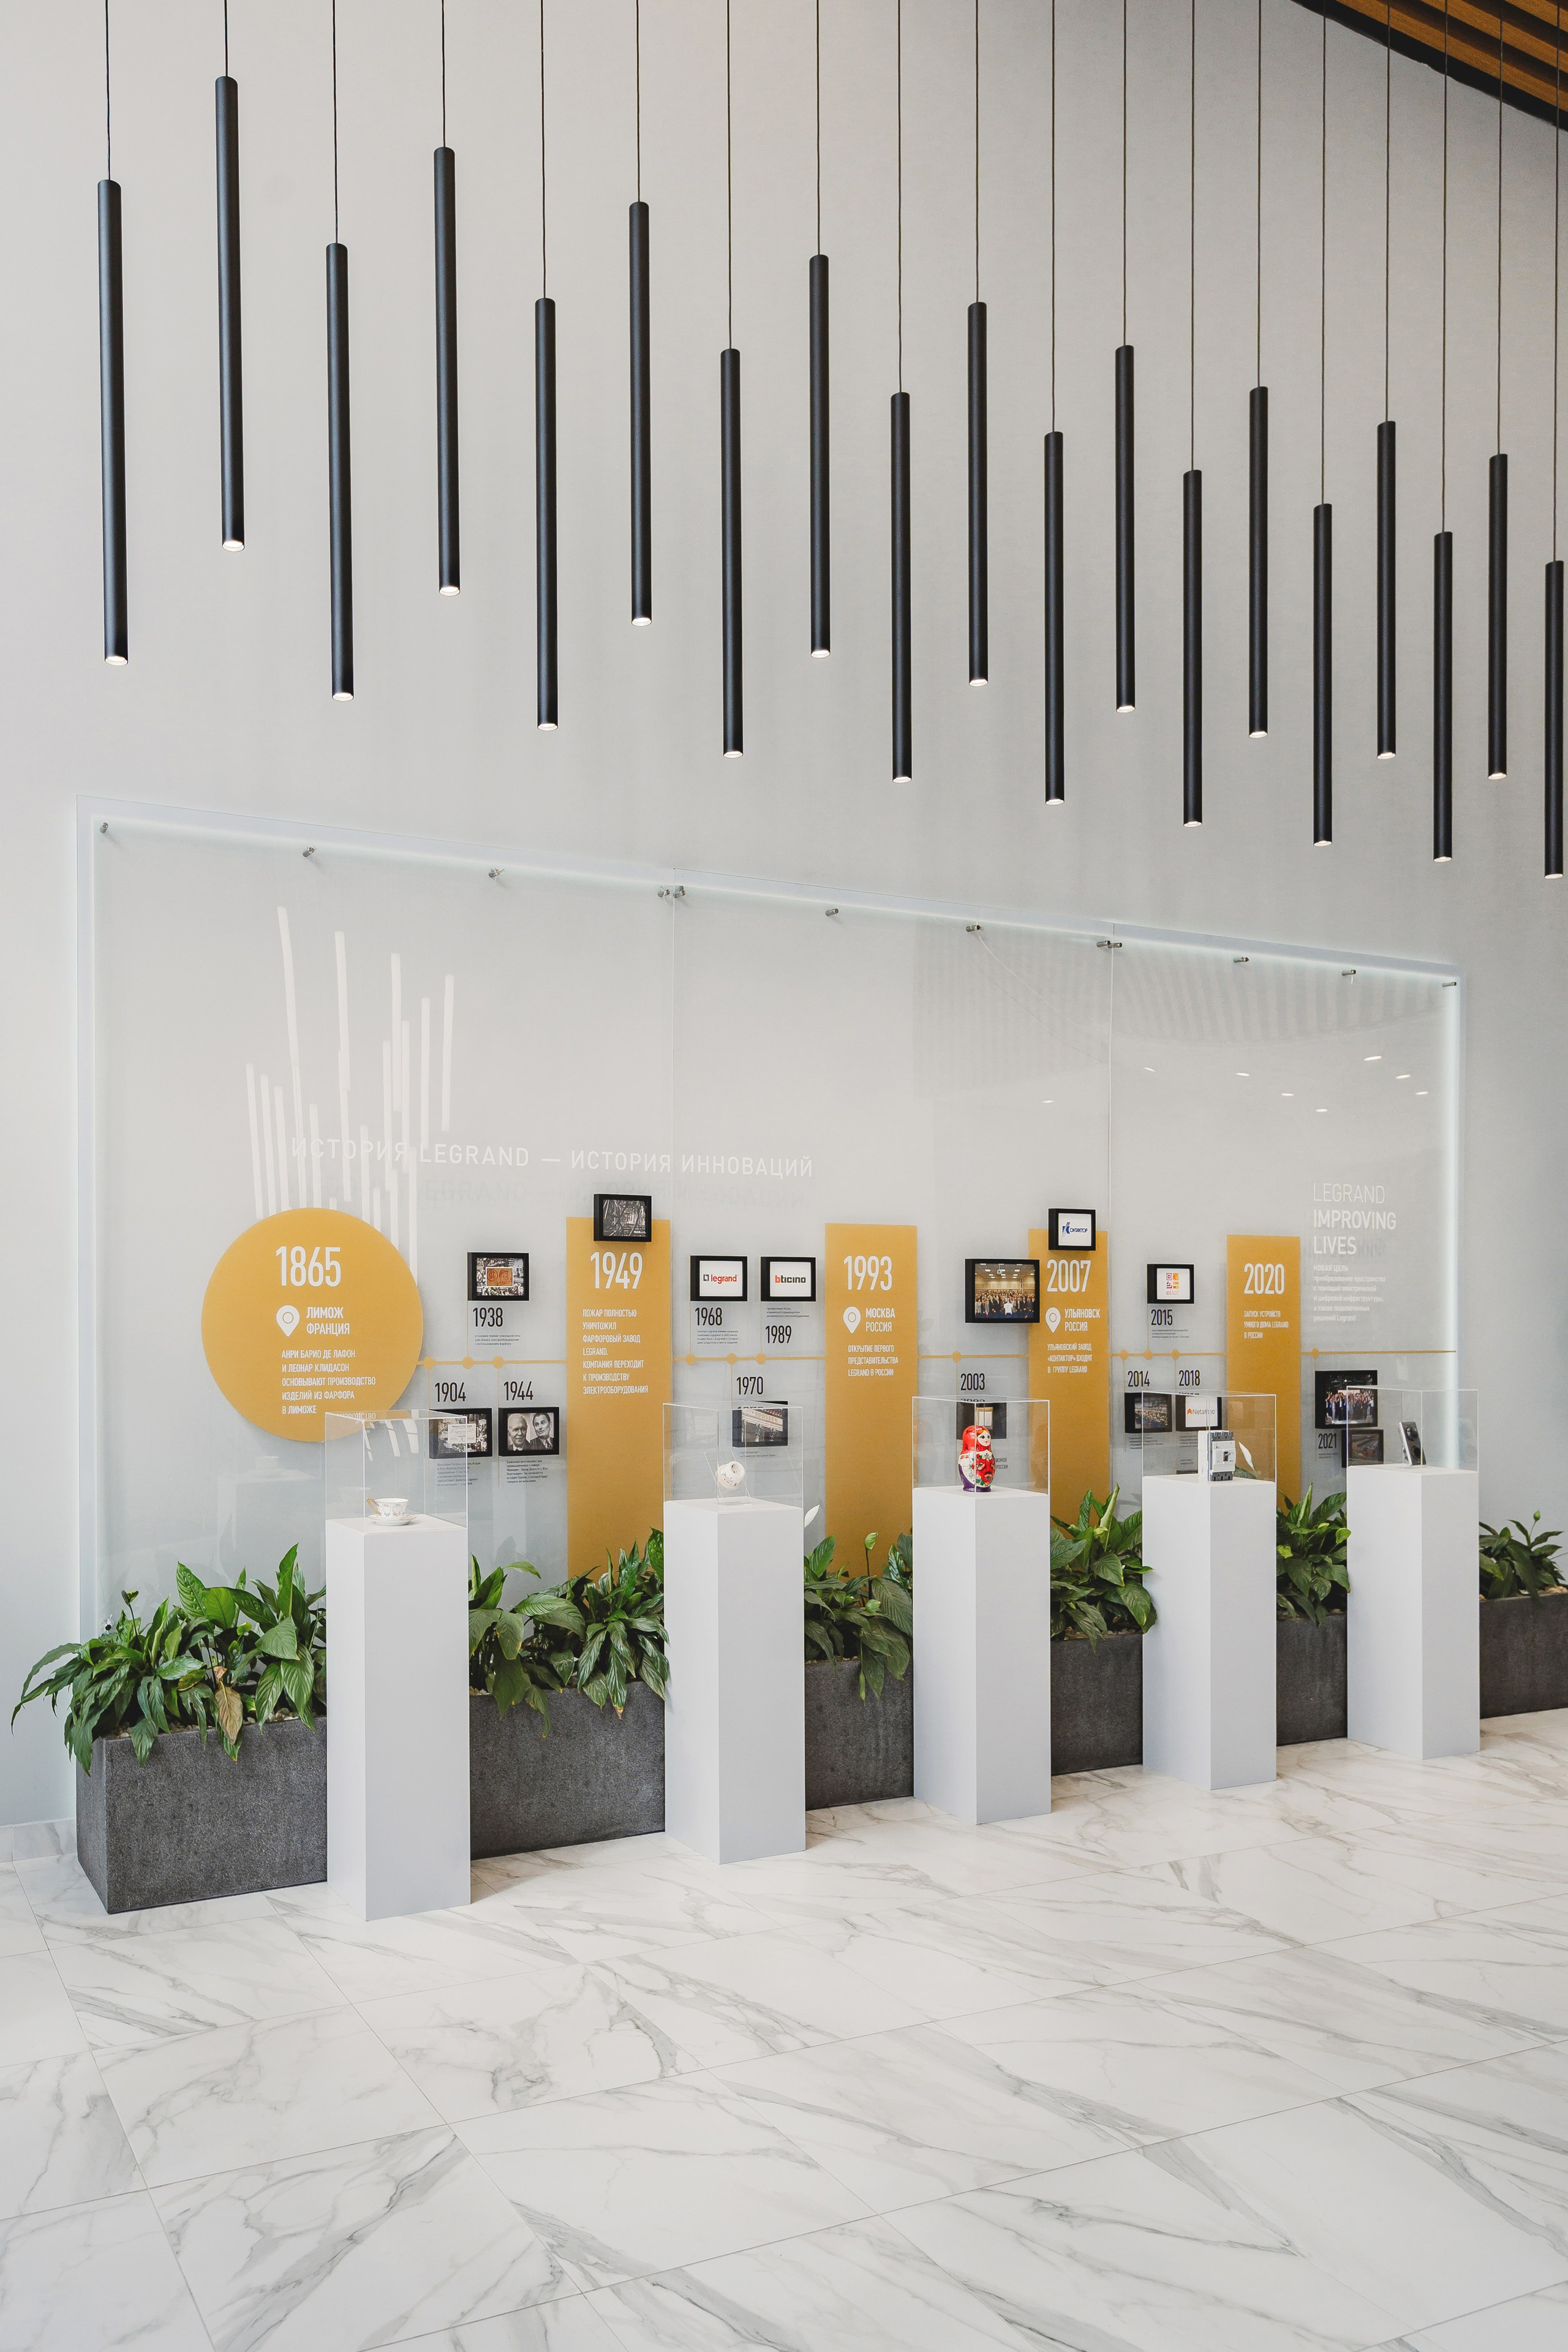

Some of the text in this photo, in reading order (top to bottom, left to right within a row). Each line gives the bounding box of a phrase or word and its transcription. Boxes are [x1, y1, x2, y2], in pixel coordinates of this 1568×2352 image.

[292, 1137, 408, 1161] ИСТОРИЯ
[420, 1144, 529, 1166] LEGRAND
[571, 1150, 671, 1172] ИСТОРИЯ
[682, 1154, 813, 1180] ИННОВАЦИЙ
[1313, 1183, 1385, 1204] LEGRAND
[1313, 1209, 1396, 1230] IMPROVING
[1313, 1235, 1357, 1255] LIVES
[276, 1246, 341, 1287] 1865
[590, 1251, 643, 1289] 1949
[843, 1255, 892, 1291] 1993
[1333, 1264, 1349, 1273] ЦЕЛЬ
[710, 1274, 737, 1284] legrand
[1047, 1259, 1091, 1292] 2007
[1244, 1263, 1284, 1294] 2020
[306, 1306, 344, 1319] ЛИМОЖ
[473, 1307, 503, 1327] 1938
[695, 1307, 722, 1326] 1968
[865, 1308, 895, 1318] МОСКВА
[1065, 1308, 1100, 1318] УЛЬЯНОВСК
[1151, 1309, 1173, 1325] 2015
[306, 1322, 350, 1336] ФРАНЦИЯ
[766, 1325, 792, 1344] 1989
[865, 1322, 892, 1332] РОССИЯ
[1065, 1321, 1088, 1332] РОССИЯ
[582, 1333, 641, 1343] ФАРФОРОВЫЙ ЗАВОД
[282, 1349, 355, 1359] АНРИ БАРИО ДЕ ЛАФОН
[848, 1356, 899, 1365] ПРЕДСТАВИТЕЛЬСТВА
[288, 1363, 312, 1373] ЛЕОНАР
[315, 1363, 349, 1373] КЛИДАСОН
[614, 1360, 644, 1368] ПЕРЕХОДИТ
[875, 1368, 894, 1376] РОССИИ
[282, 1376, 376, 1386] ОСНОВЫВАЮТ ПРОИЗВОДСТВО
[589, 1373, 630, 1382] ПРОИЗВОДСТВУ
[736, 1376, 763, 1395] 1970
[960, 1373, 985, 1390] 2003
[1128, 1370, 1150, 1387] 2014
[1178, 1370, 1200, 1386] 2018
[282, 1390, 355, 1401] ИЗДЕЛИЙ ИЗ ФАРФОРА
[435, 1382, 466, 1402] 1904
[504, 1381, 533, 1401] 1944
[582, 1385, 648, 1394] ЭЛЕКТРООБОРУДОВАНИЯ
[282, 1405, 317, 1414] В ЛИМОЖЕ
[1318, 1433, 1337, 1449] 2021
